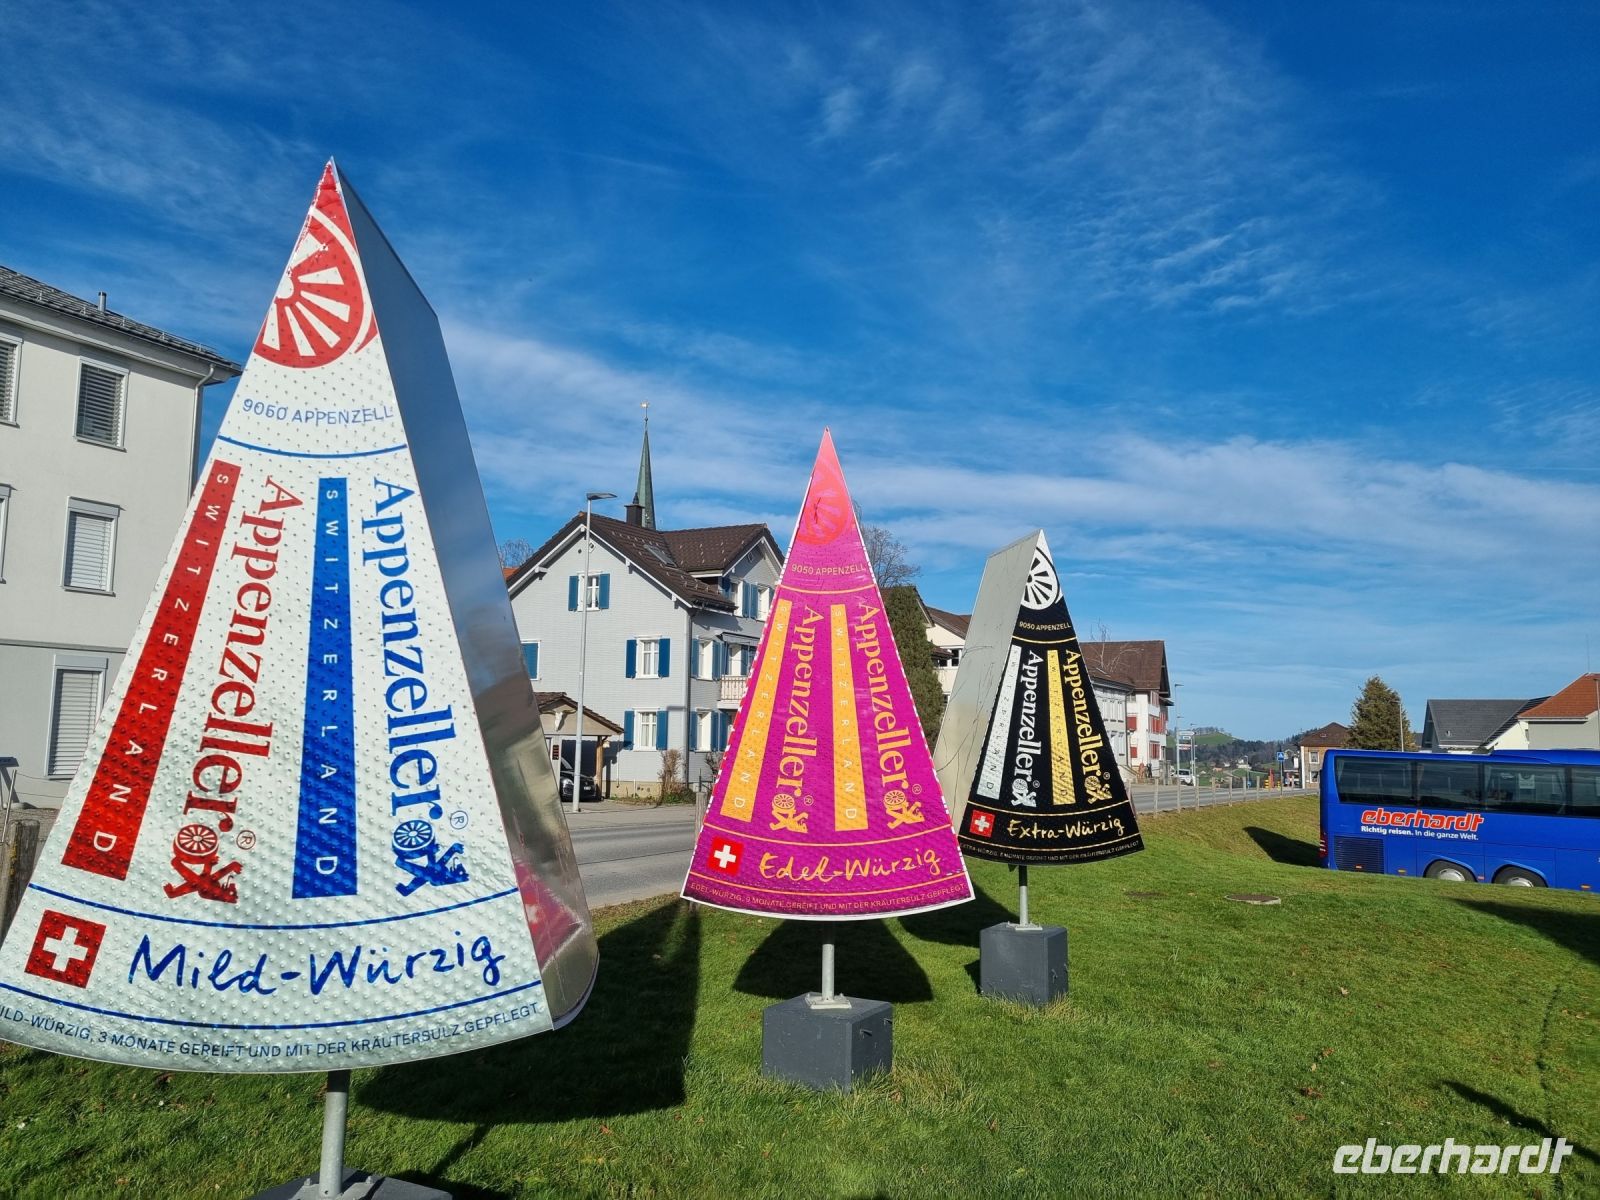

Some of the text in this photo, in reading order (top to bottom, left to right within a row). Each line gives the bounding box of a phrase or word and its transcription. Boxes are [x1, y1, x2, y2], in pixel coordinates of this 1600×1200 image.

[291, 406, 393, 425] APPENZELL
[792, 563, 866, 575] 9050 APPENZELL
[93, 474, 229, 852] SWITZERLAND
[182, 476, 303, 832] Appenzeller
[362, 477, 457, 822] Appenzeller
[1036, 622, 1071, 630] APPENZELL
[316, 490, 339, 875] SWITZERLAND
[734, 606, 787, 809] SWITZERLAND
[776, 605, 824, 797] Appenzeller
[835, 610, 857, 819] SWITZERLAND
[853, 602, 912, 790] Appenzeller
[1014, 651, 1044, 782] Appenzeller
[1063, 649, 1103, 776] Appenzeller
[759, 847, 941, 882] Edel-Würzig
[1006, 814, 1125, 839] Extra-Würzig
[1361, 807, 1484, 832] eberhardt
[1361, 826, 1387, 835] Richtig
[1388, 828, 1414, 836] reisen.
[1459, 832, 1479, 840] Welt.
[752, 896, 783, 907] MONATE
[838, 902, 853, 910] MIT
[854, 901, 869, 909] DER
[927, 883, 965, 899] GEPFLEGT
[129, 930, 506, 995] Mild-Würzig
[99, 1031, 107, 1043] 3
[110, 1034, 175, 1053] MONATE
[180, 1043, 245, 1057] GEREIFT
[249, 1045, 281, 1058] UND
[286, 1044, 310, 1057] MIT
[317, 1042, 346, 1055] DER
[351, 1024, 460, 1051] KRÄUTERSULZ
[465, 1002, 539, 1033] GEPFLEGT
